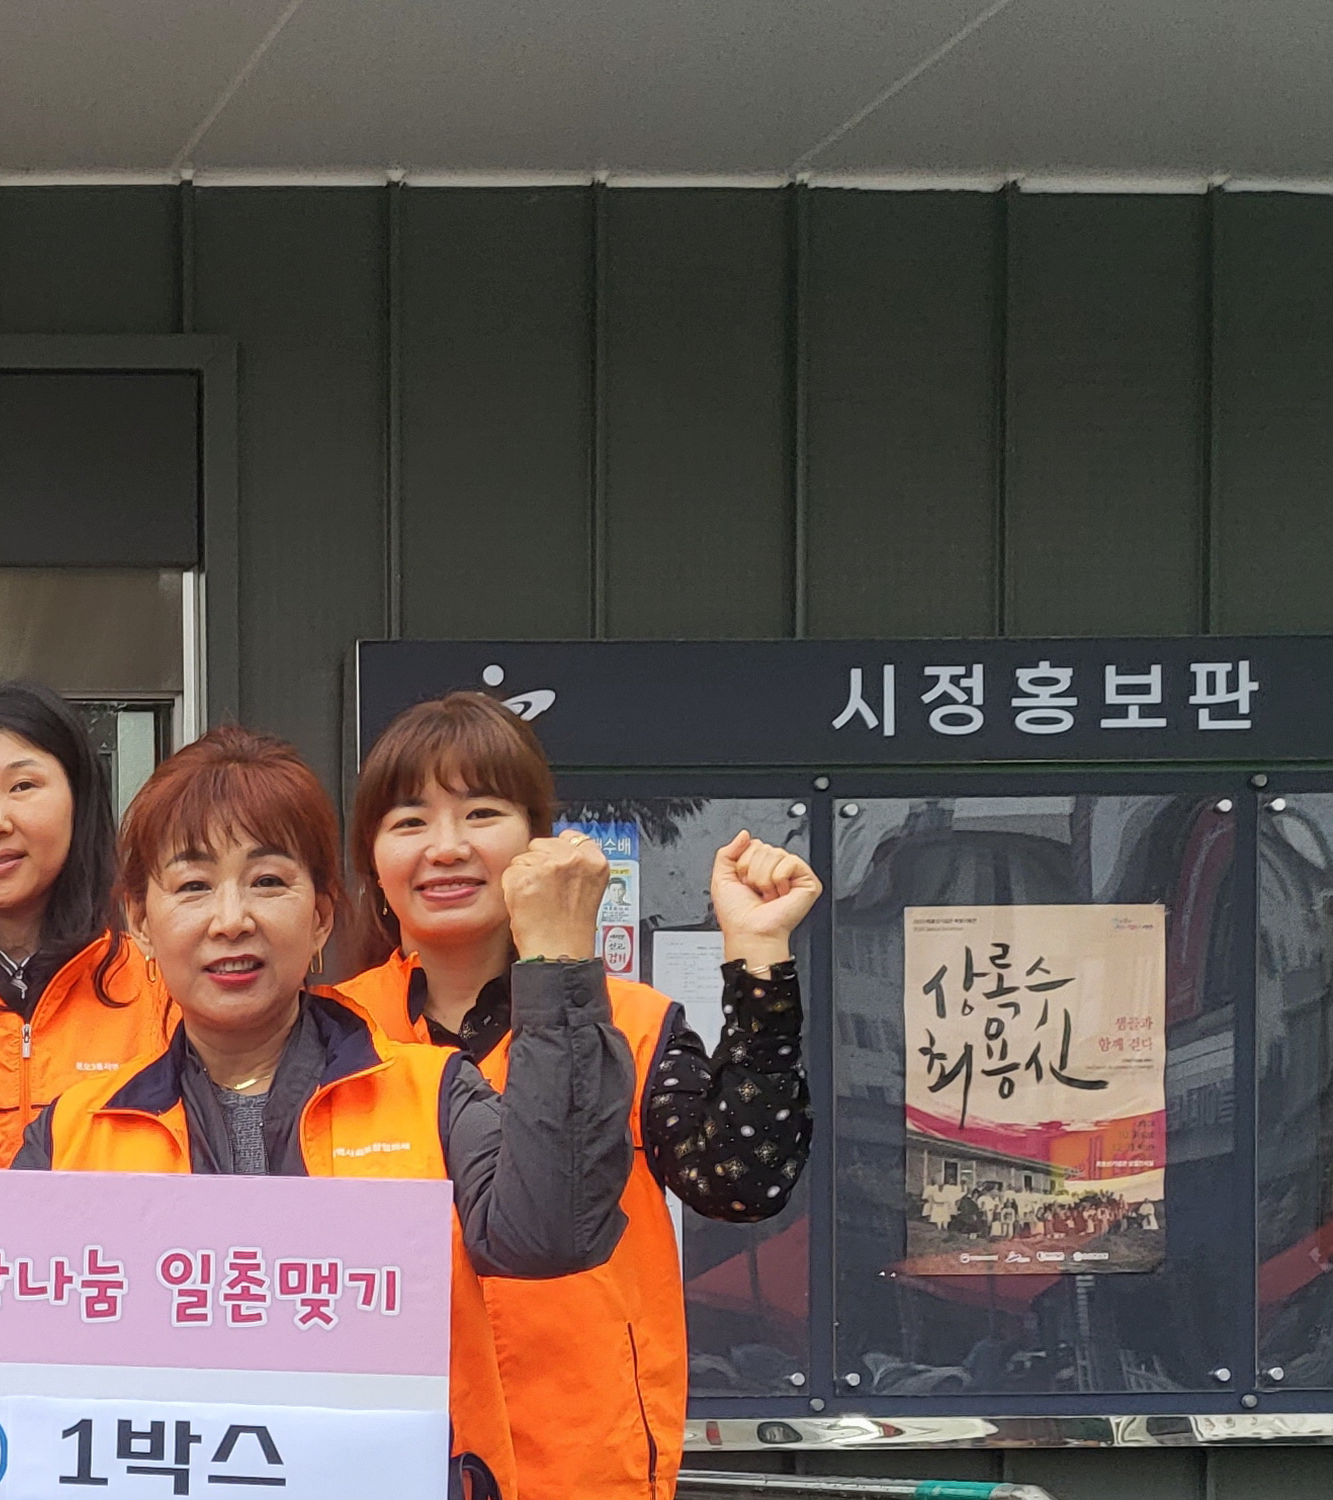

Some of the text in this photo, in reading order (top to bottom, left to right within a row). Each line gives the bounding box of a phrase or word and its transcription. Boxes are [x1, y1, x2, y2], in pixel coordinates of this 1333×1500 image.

[831, 659, 1260, 737] 시정홍보판
[160, 1249, 400, 1328] 일촌맺기
[59, 1418, 286, 1495] 1박스
